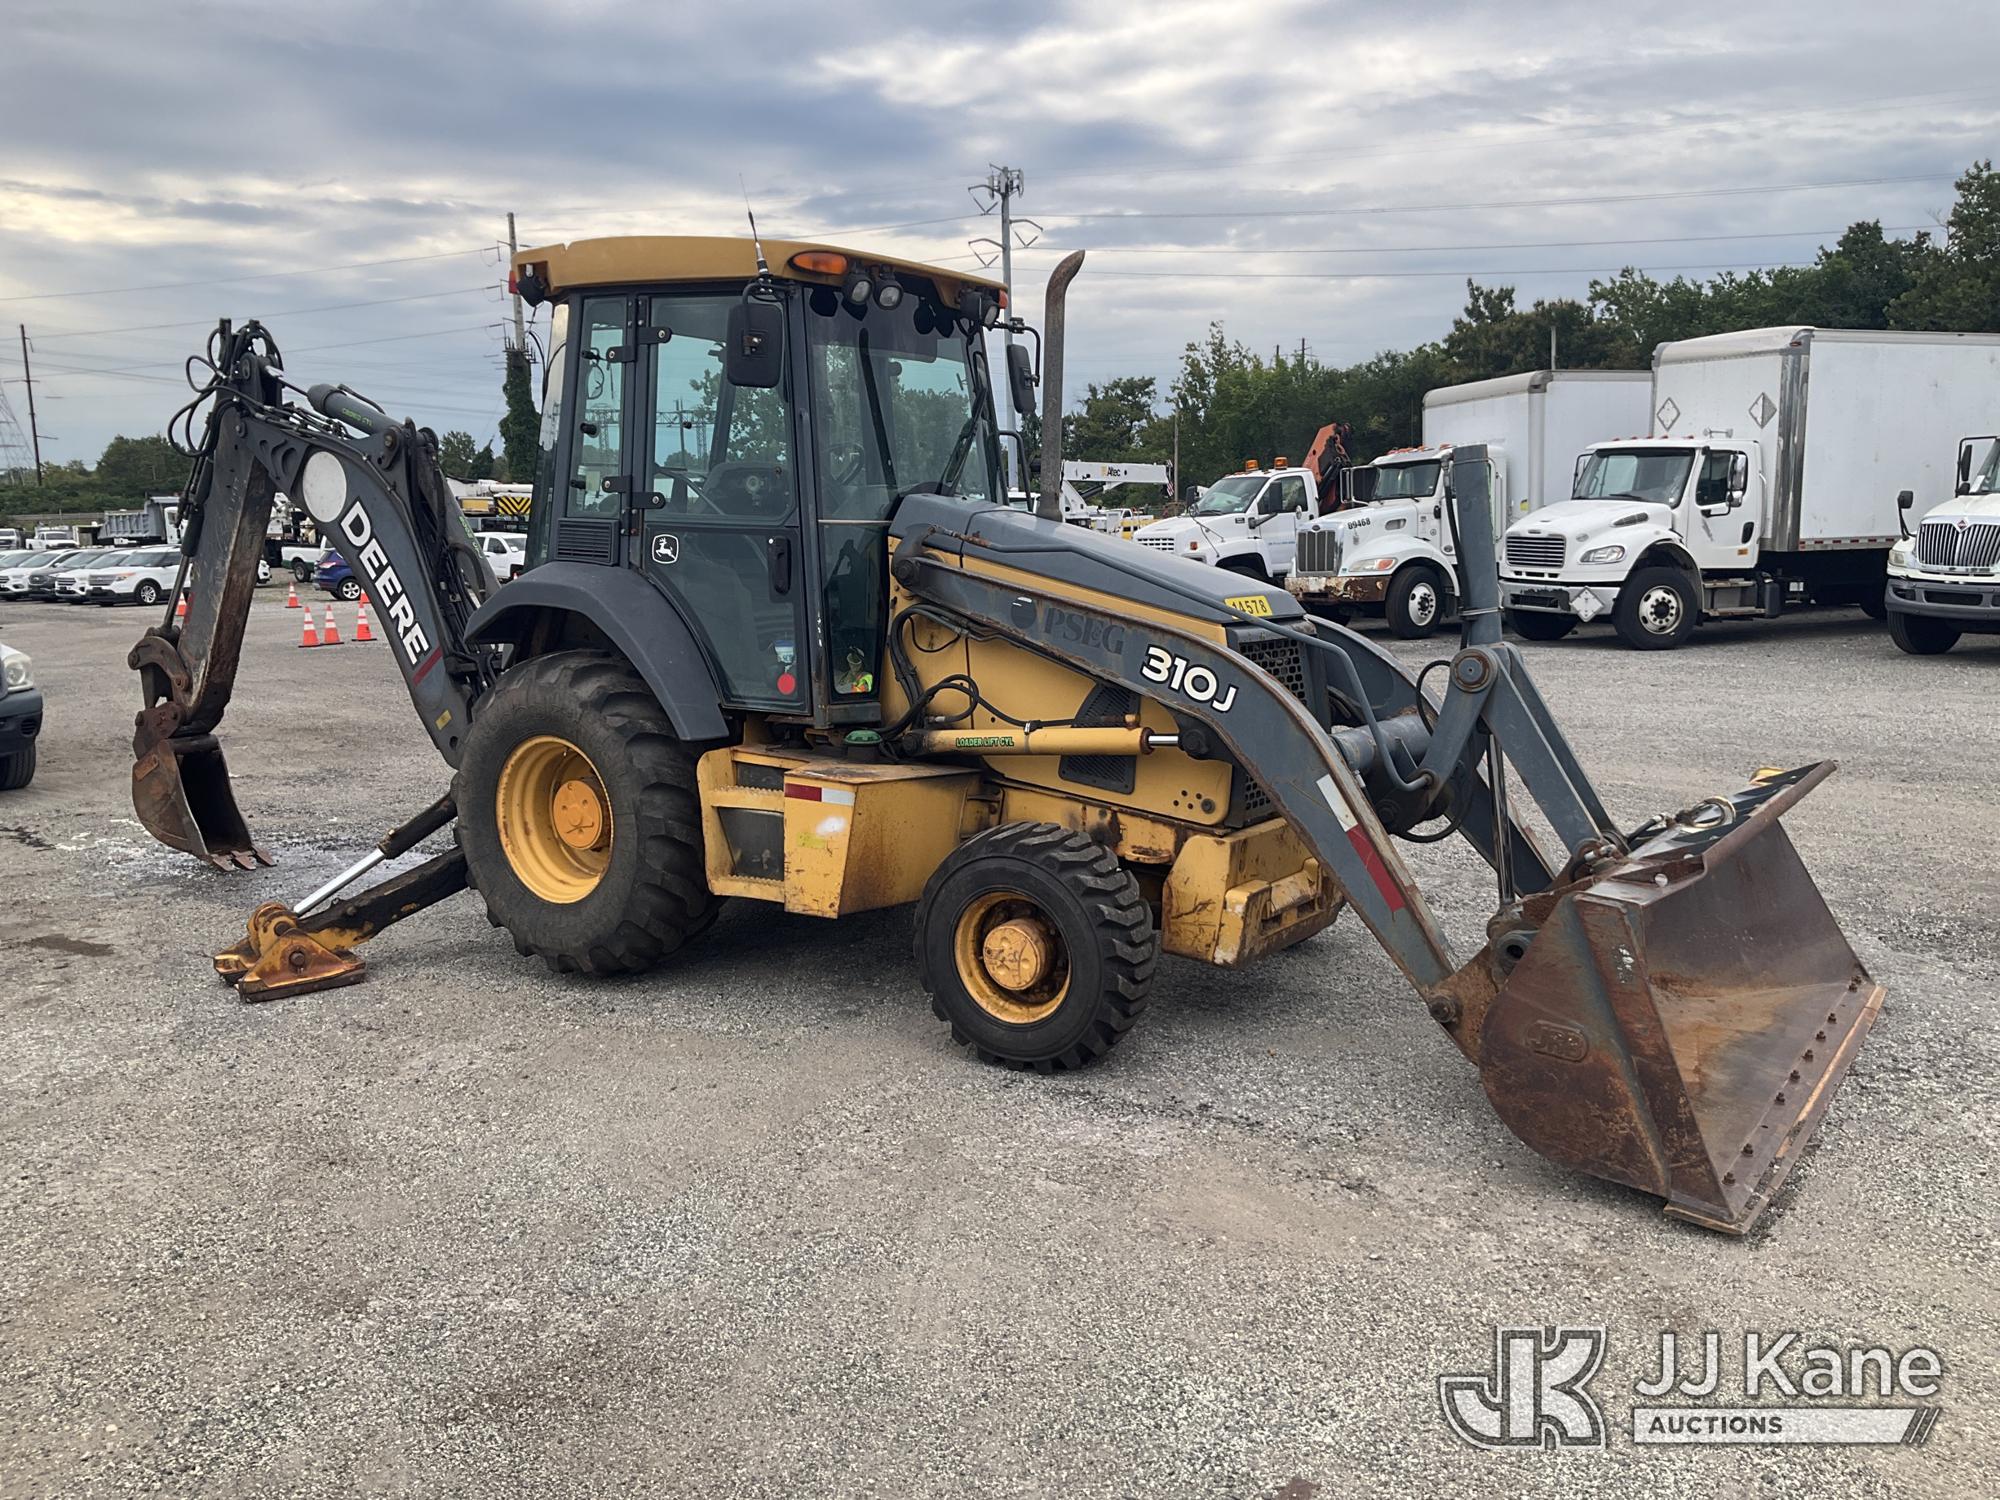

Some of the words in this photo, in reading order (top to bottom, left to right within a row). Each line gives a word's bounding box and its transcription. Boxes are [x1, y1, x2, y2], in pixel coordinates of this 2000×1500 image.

[1106, 466, 1121, 477] Altec
[340, 500, 430, 666] DEERE
[1140, 645, 1239, 713] 310J
[955, 736, 983, 748] LOADER
[983, 736, 999, 748] LIFT
[999, 736, 1014, 747] CYL
